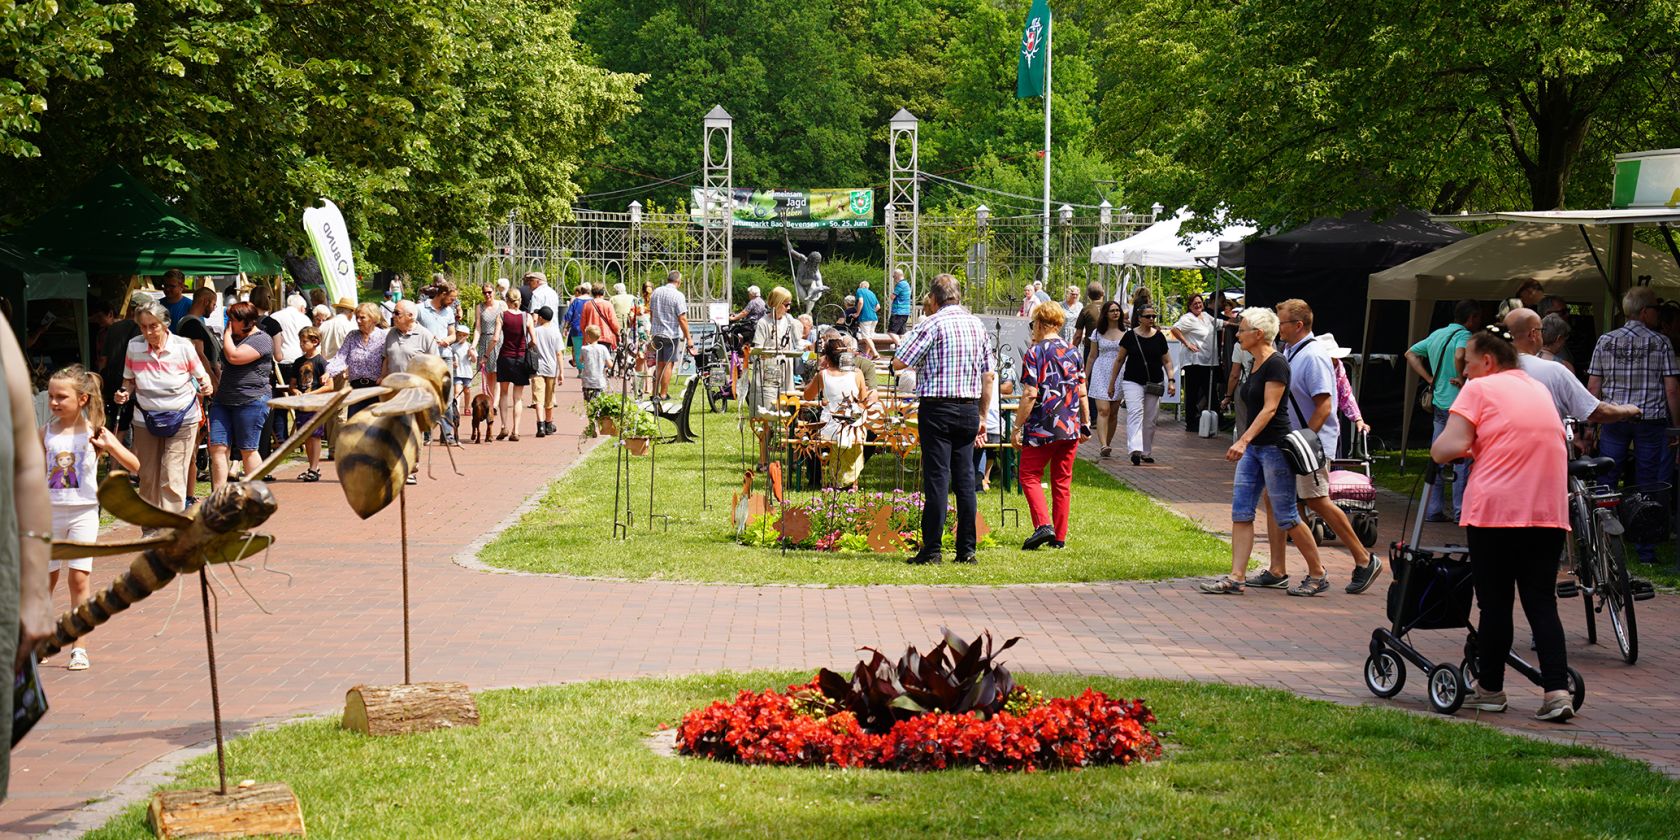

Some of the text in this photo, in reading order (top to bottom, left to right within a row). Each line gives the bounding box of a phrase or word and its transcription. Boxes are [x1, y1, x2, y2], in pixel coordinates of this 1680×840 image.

[786, 198, 807, 209] Jagd
[786, 220, 819, 229] Bevensen
[853, 219, 868, 227] Juni
